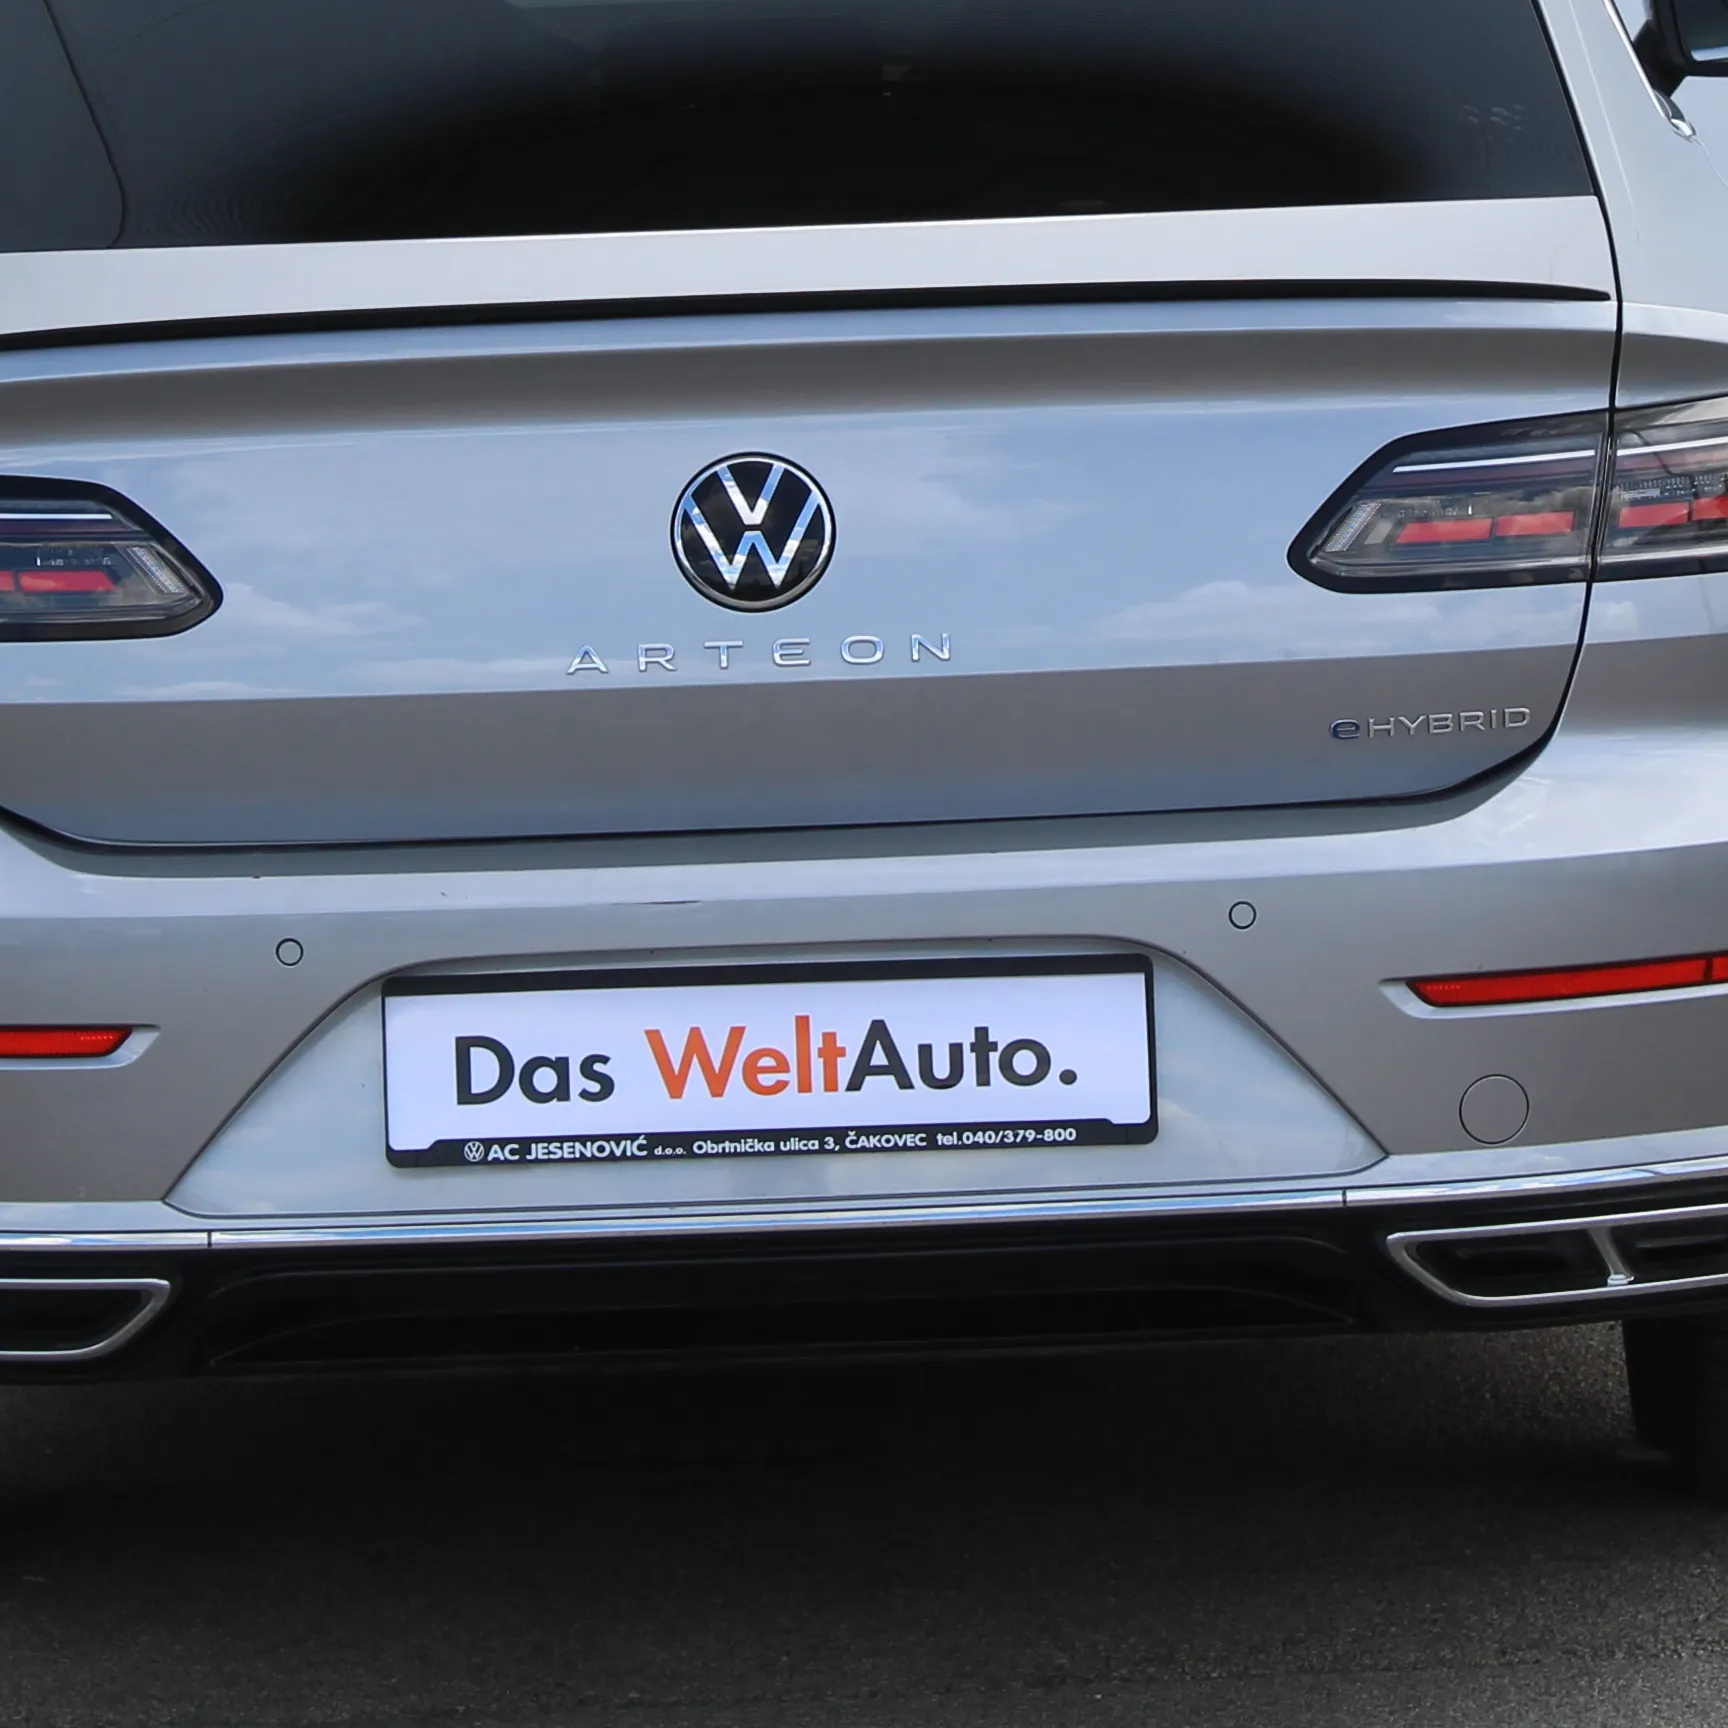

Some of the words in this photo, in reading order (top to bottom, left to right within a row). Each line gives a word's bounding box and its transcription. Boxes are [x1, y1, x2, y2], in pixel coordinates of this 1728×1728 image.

[566, 632, 952, 675] ARTEON
[454, 1035, 616, 1106] Das
[644, 1015, 1078, 1100] WeltAuto.
[487, 1144, 519, 1161] AC
[525, 1135, 648, 1161] JESENOVIĆ
[654, 1144, 687, 1156] d.o.o.
[692, 1138, 775, 1155] Obrtnička
[779, 1137, 819, 1152] ulica
[823, 1137, 841, 1152] 3,
[844, 1129, 928, 1150] ČAKOVEC
